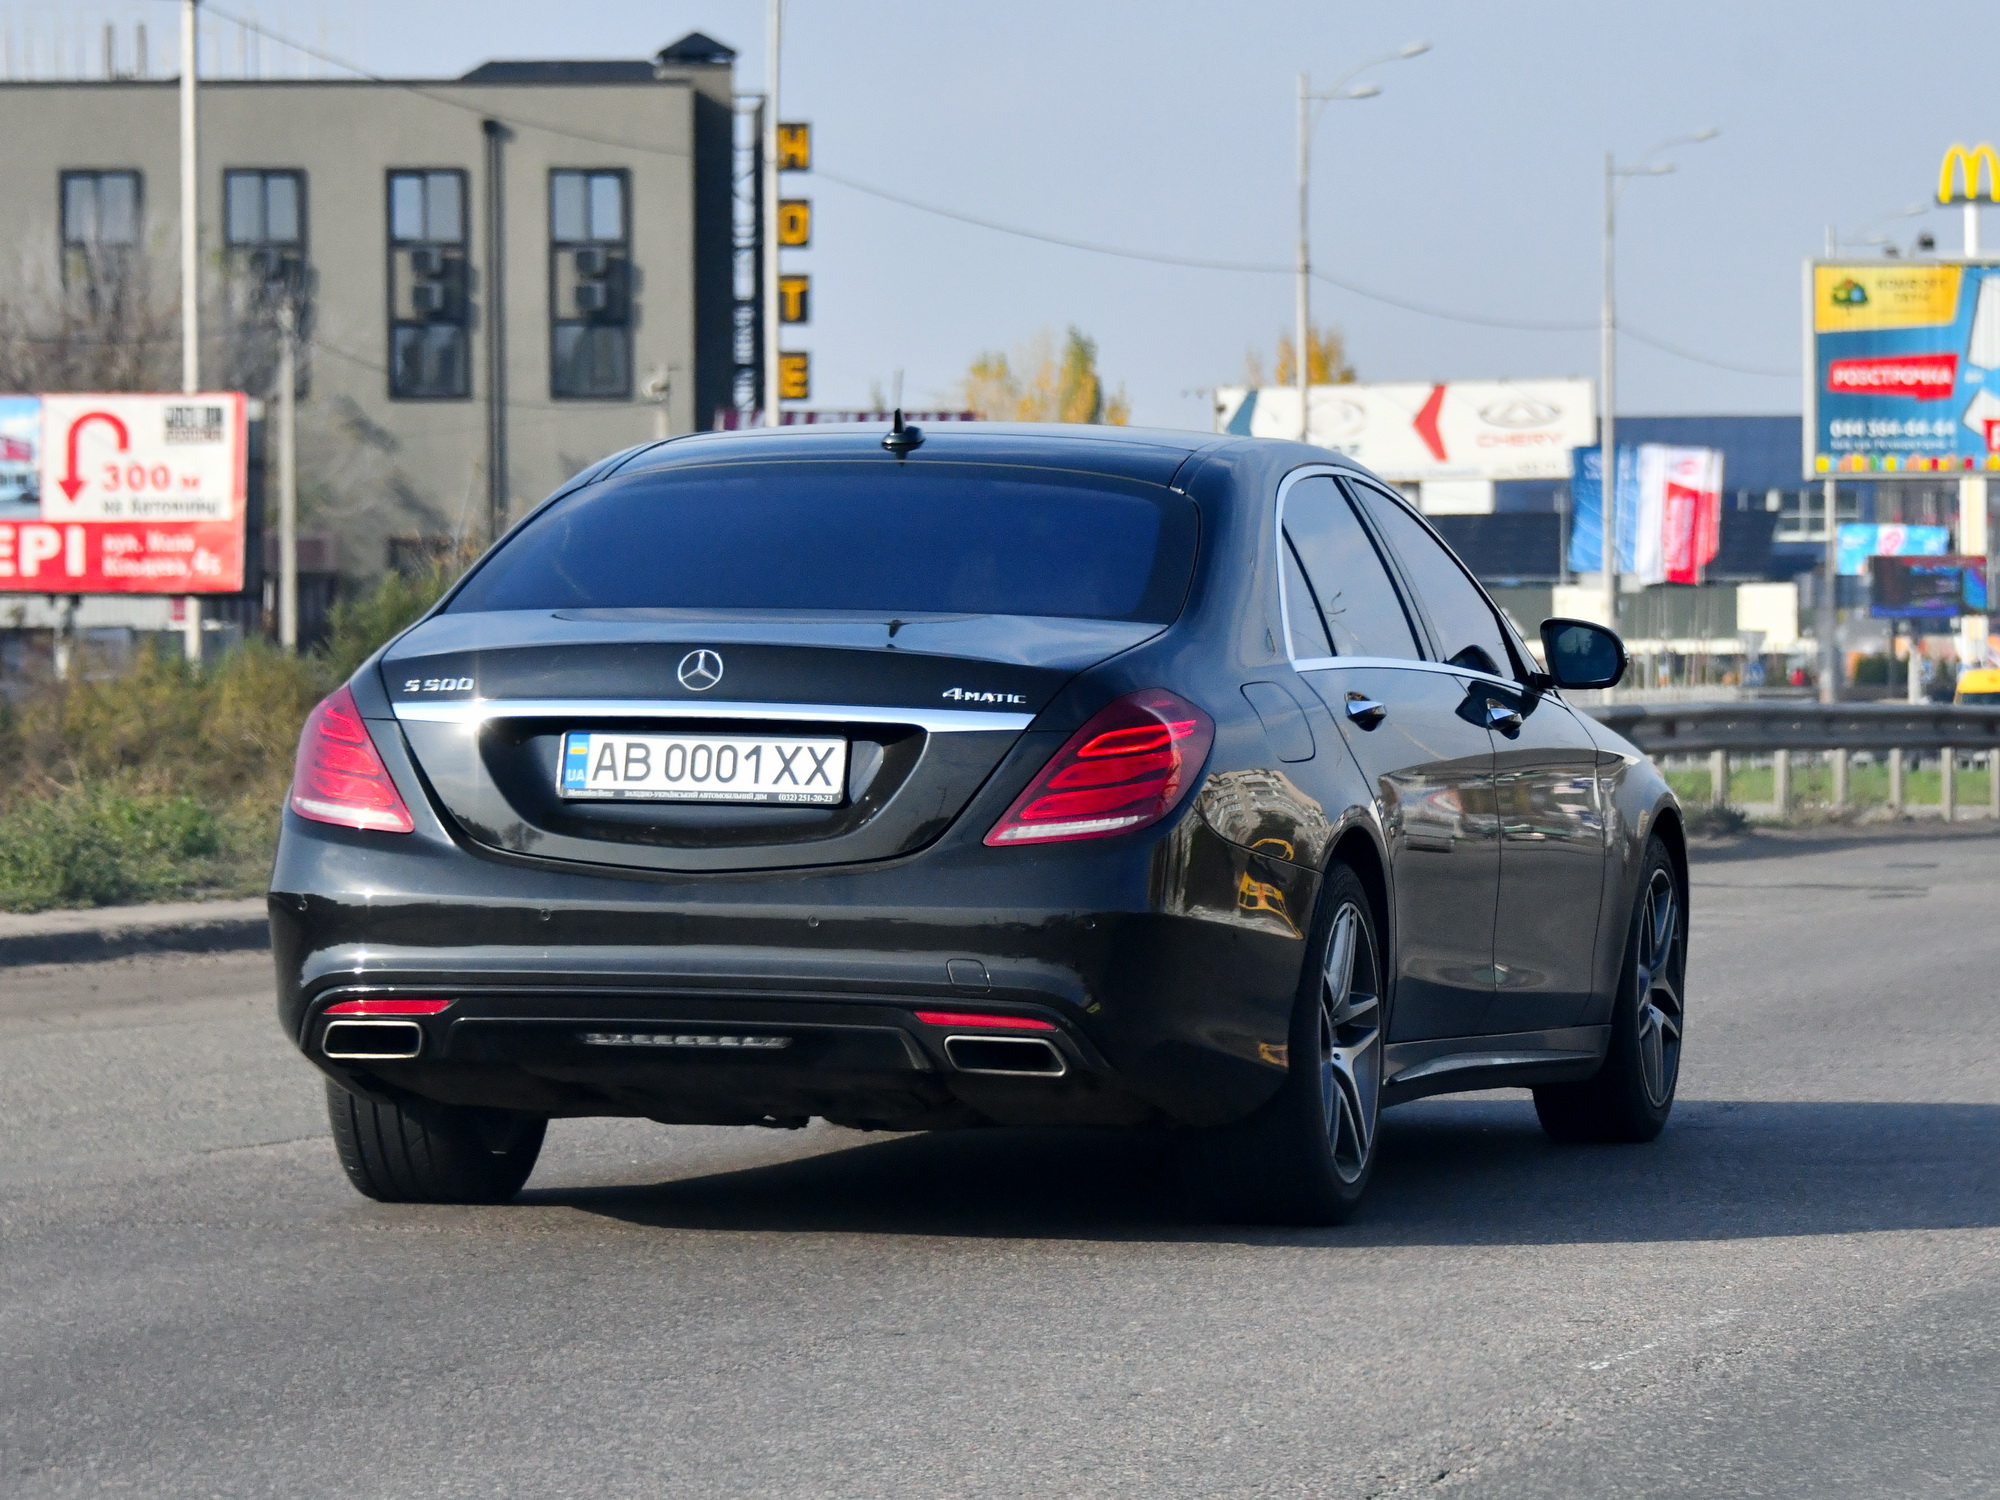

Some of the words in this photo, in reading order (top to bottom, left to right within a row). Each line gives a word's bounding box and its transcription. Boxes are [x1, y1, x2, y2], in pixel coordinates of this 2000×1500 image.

[1476, 431, 1563, 448] CHERY
[102, 465, 170, 491] 300
[403, 678, 420, 692] S
[422, 677, 475, 692] 500
[942, 687, 1027, 704] 4MATIC
[592, 742, 651, 782] AB
[566, 769, 585, 782] UA
[778, 793, 798, 802] (032)
[798, 794, 833, 803] 251-20-23
